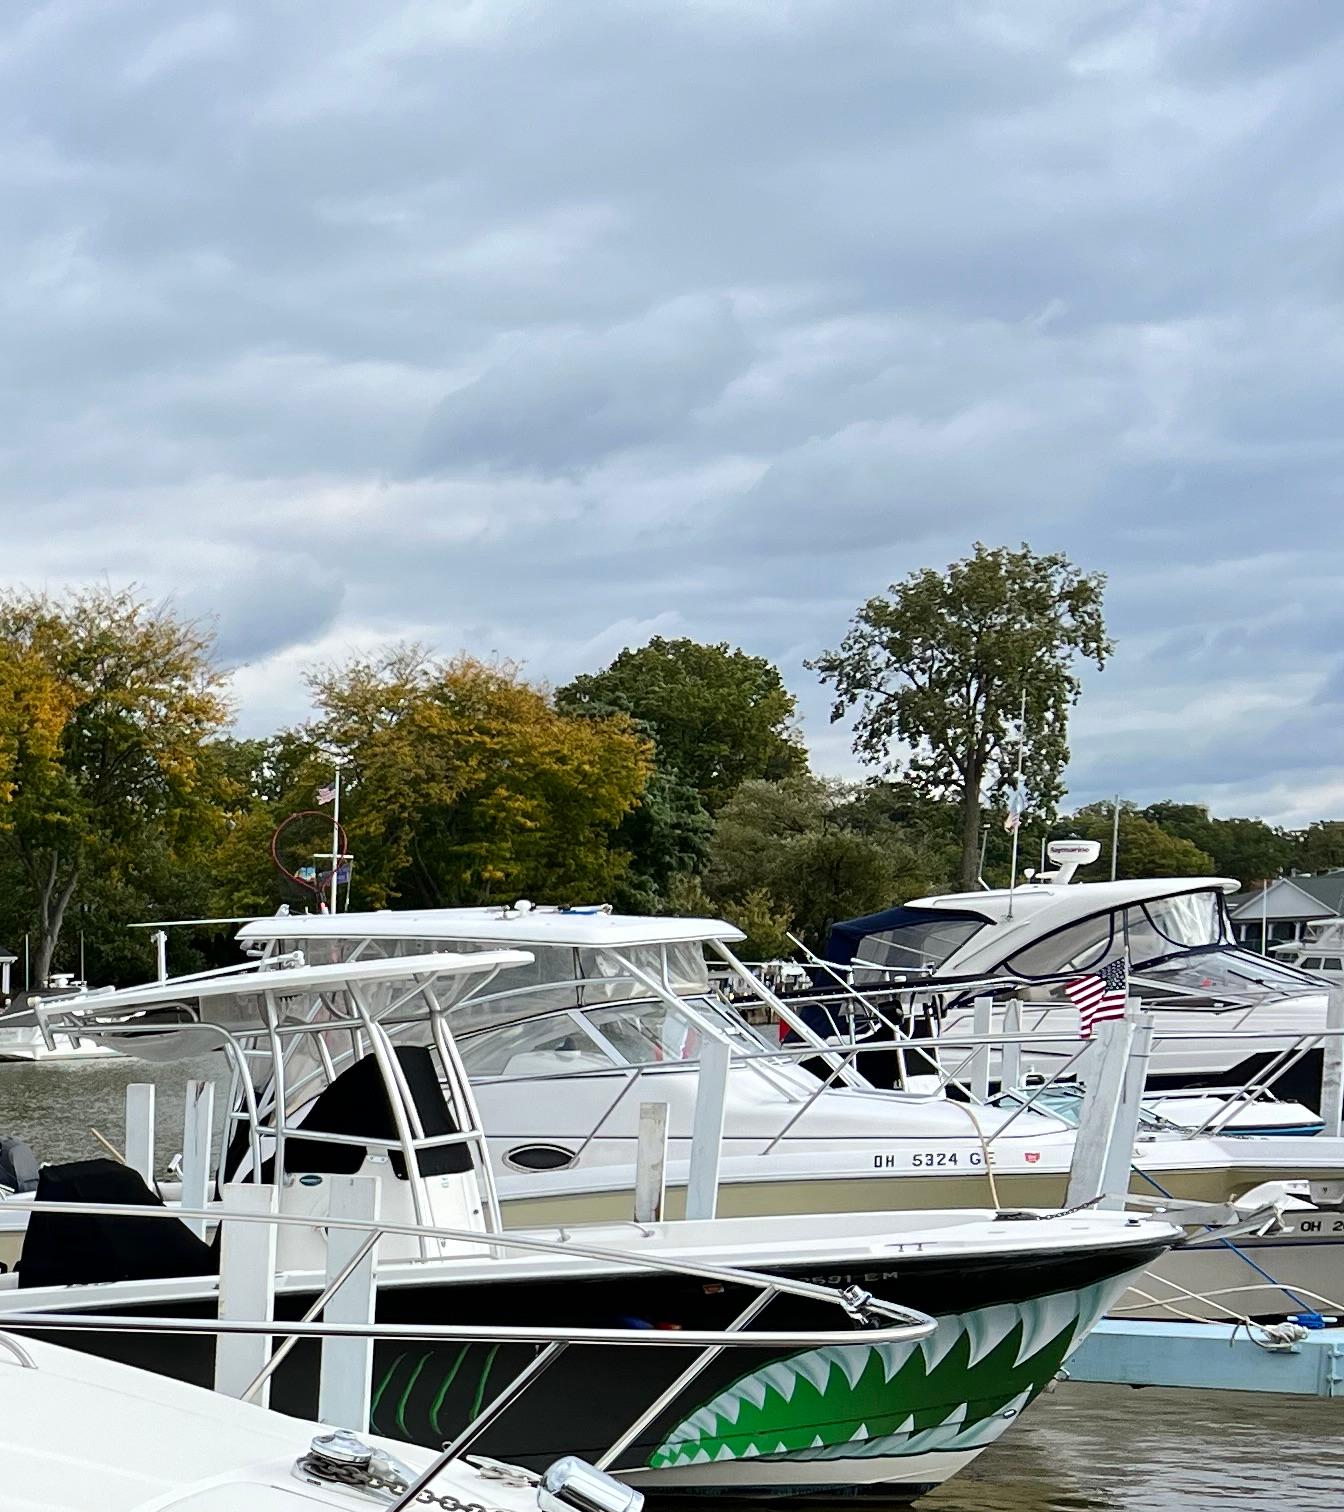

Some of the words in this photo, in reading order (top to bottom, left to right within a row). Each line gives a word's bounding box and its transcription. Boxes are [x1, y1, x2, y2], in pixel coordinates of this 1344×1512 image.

[874, 1155, 895, 1168] OH
[912, 1152, 958, 1167] 5324
[1300, 1220, 1322, 1232] OH
